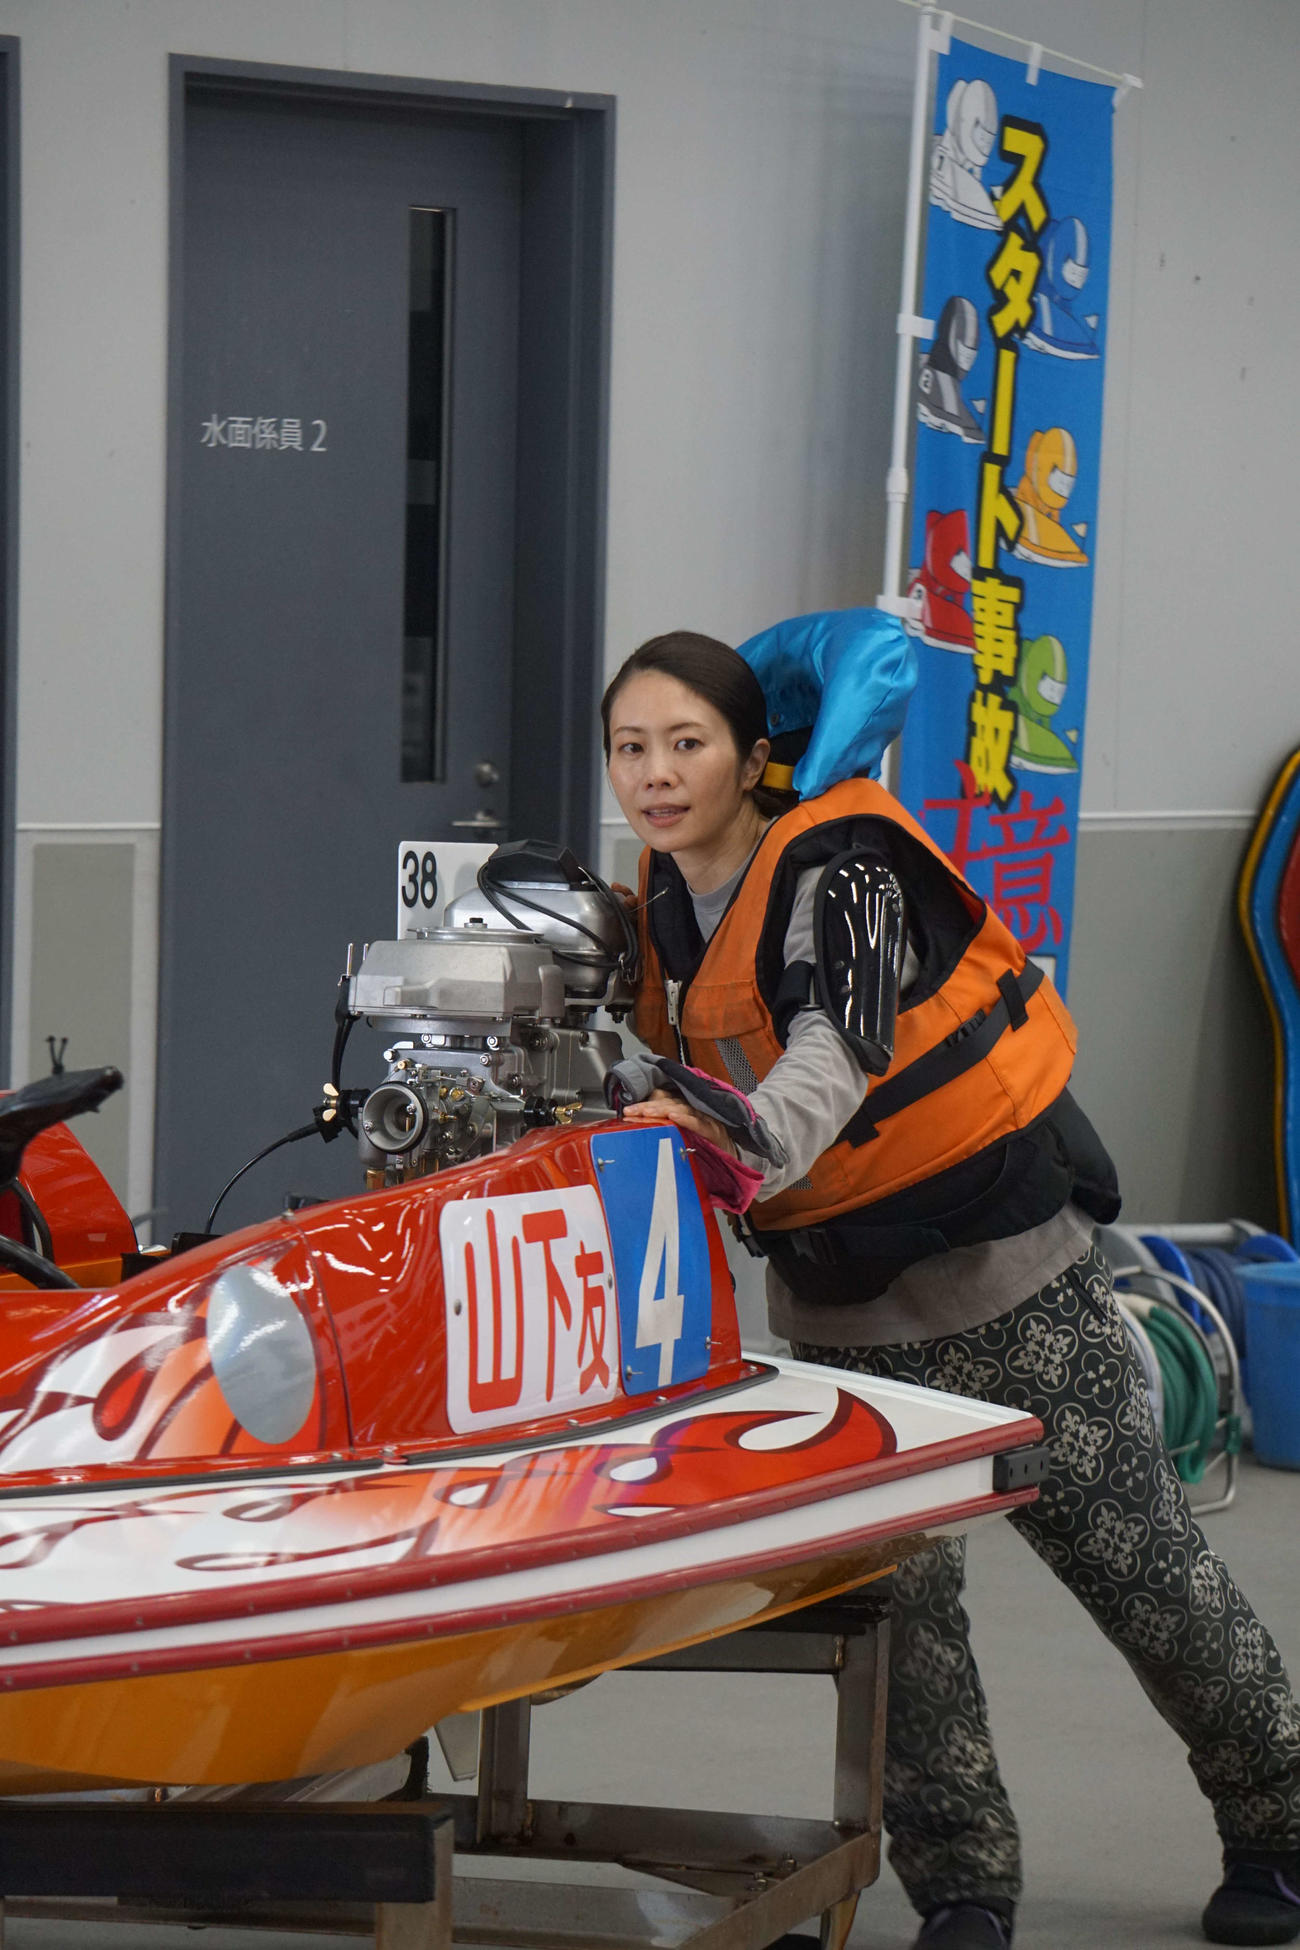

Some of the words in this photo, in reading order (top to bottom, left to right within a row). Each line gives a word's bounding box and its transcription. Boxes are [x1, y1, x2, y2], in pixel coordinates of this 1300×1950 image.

[200, 413, 304, 451] 水面係員
[310, 419, 328, 452] 2
[965, 117, 1048, 808] スタート事故
[401, 850, 438, 908] 38
[464, 1207, 610, 1414] 山下友
[635, 1138, 685, 1387] 4
